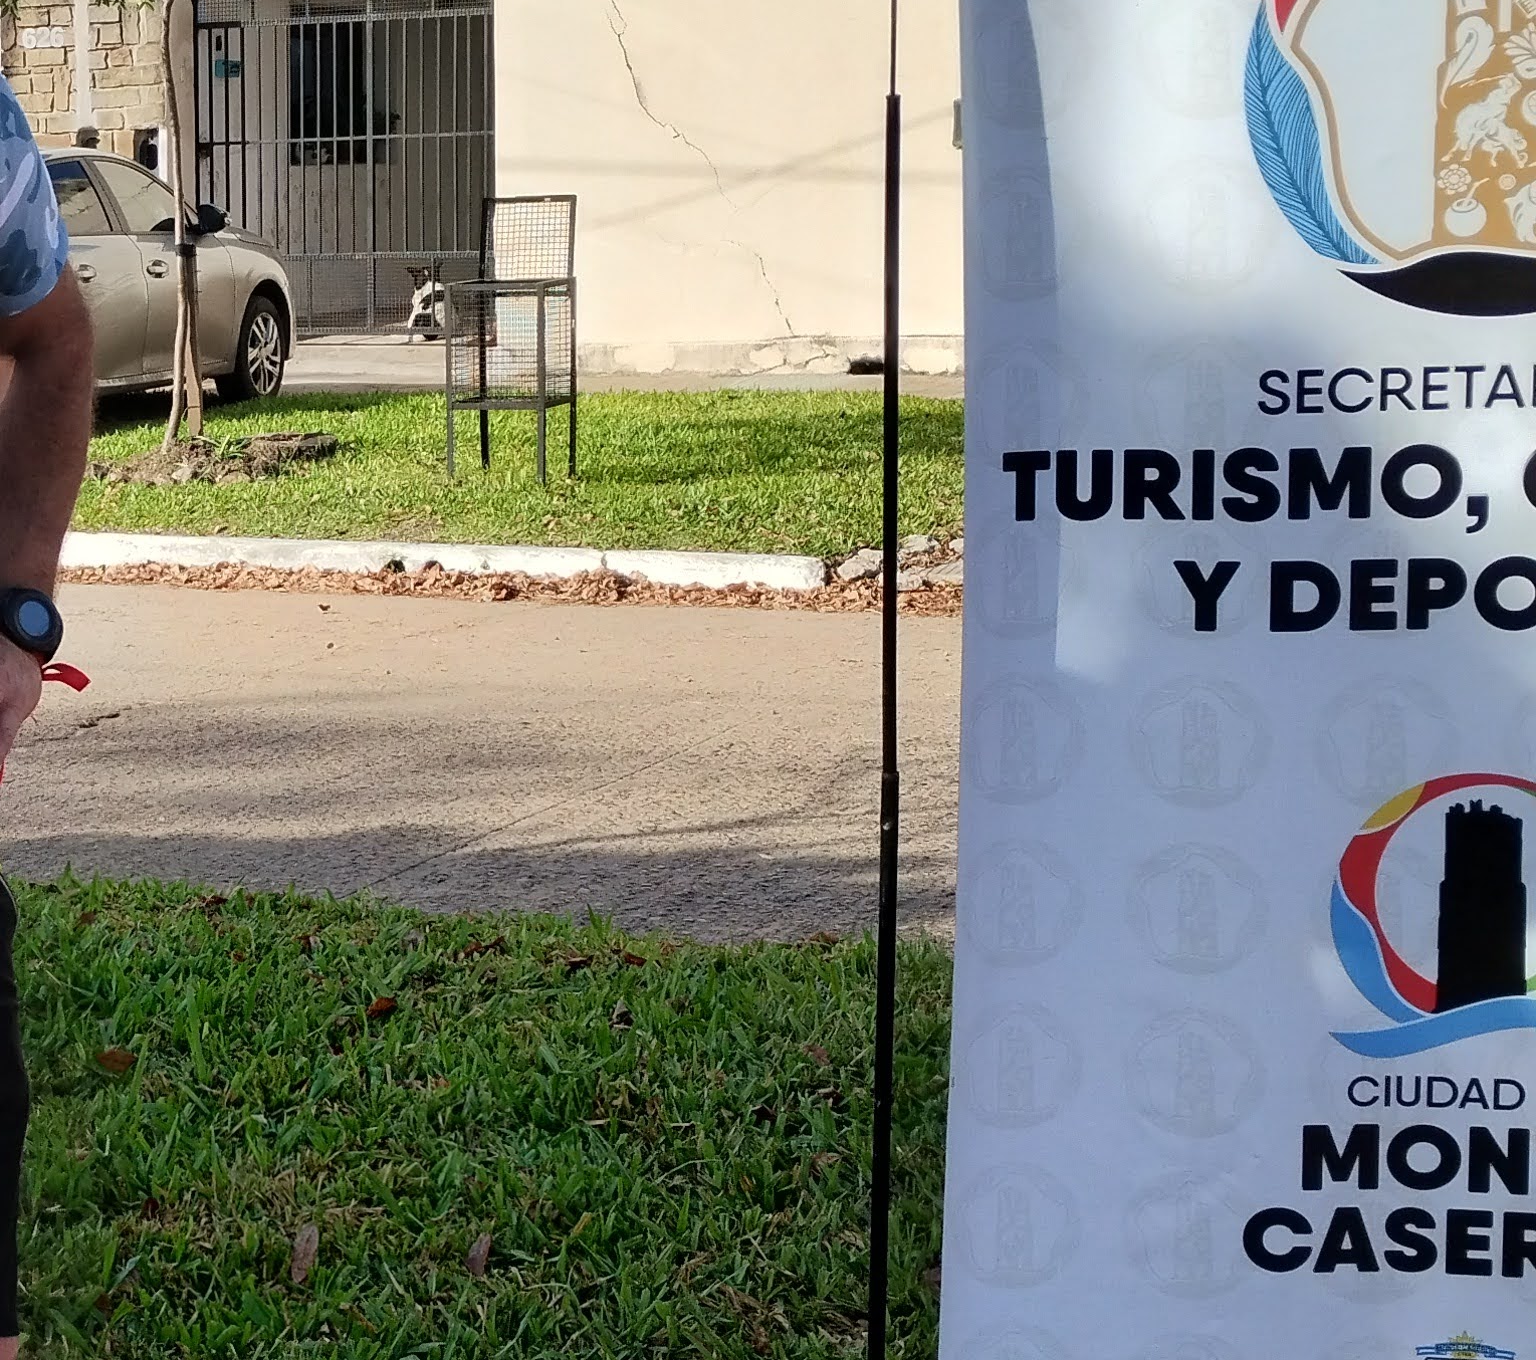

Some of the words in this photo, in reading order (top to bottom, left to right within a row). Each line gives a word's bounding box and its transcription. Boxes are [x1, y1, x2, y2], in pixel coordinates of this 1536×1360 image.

[22, 27, 64, 48] 626
[1257, 364, 1536, 416] SECRETA
[1002, 444, 1489, 533] TURISMO,
[1173, 559, 1241, 632] Y
[1269, 555, 1536, 633] DEPO
[1347, 1075, 1526, 1110] CIUDAD
[1302, 1124, 1530, 1195] MON
